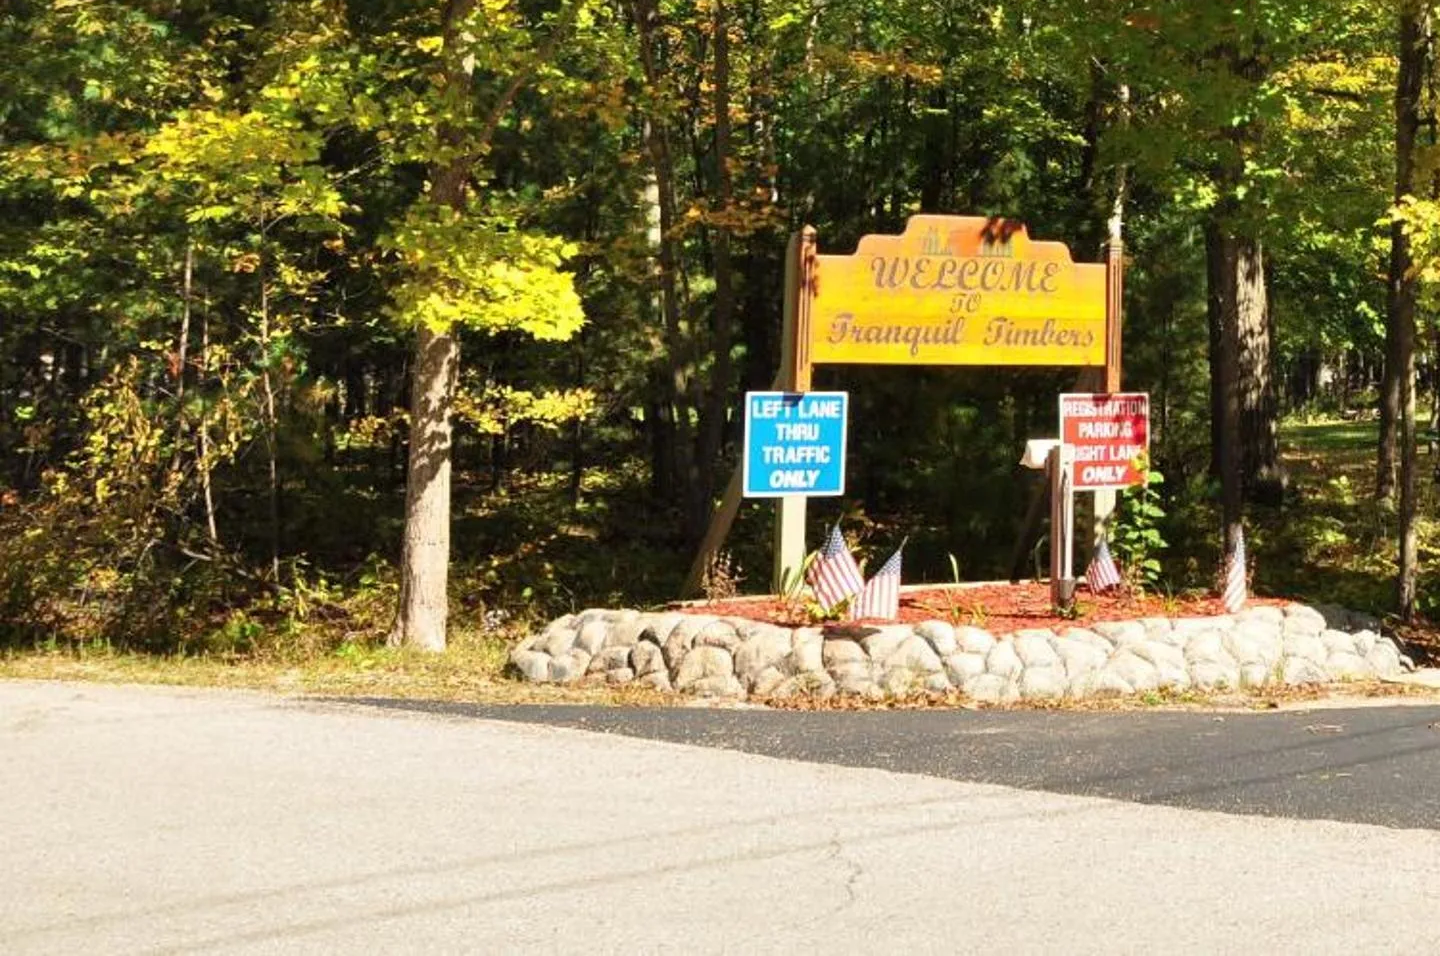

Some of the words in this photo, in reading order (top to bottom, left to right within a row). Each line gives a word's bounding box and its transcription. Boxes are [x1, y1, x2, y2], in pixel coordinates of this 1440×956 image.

[870, 256, 1061, 293] WELCOME
[826, 312, 966, 357] Tranquil
[983, 317, 1094, 347] Timbers
[752, 400, 792, 419] LEFT
[798, 400, 841, 419] LANE
[775, 423, 820, 441] THRU
[762, 445, 831, 464] TRAFFIC
[769, 469, 820, 488] ONLY
[1082, 465, 1128, 484] ONLY
